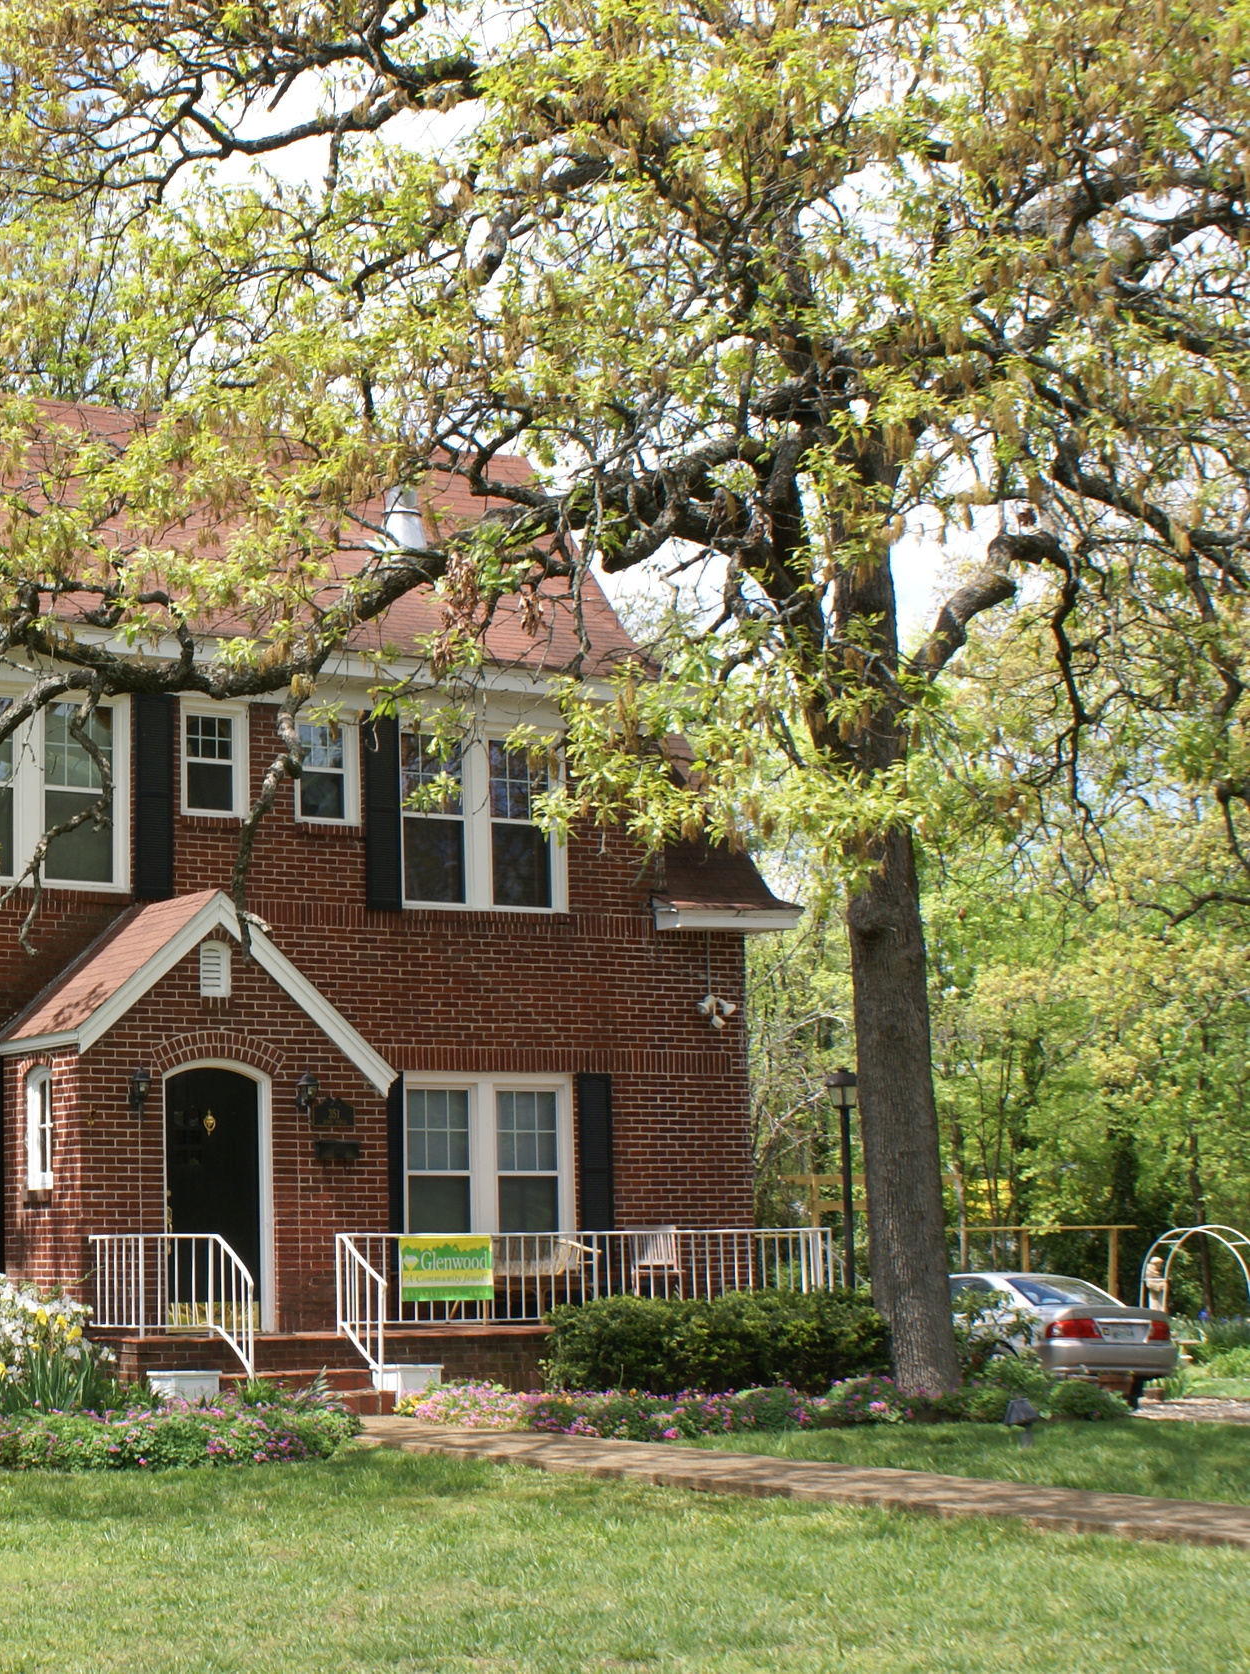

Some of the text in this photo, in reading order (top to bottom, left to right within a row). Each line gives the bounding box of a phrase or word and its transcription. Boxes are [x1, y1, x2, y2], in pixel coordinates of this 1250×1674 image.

[328, 1109, 340, 1119] 351
[421, 1251, 487, 1271] Glenwood
[416, 1274, 461, 1284] Community
[405, 1290, 461, 1298] ESTABLISHED
